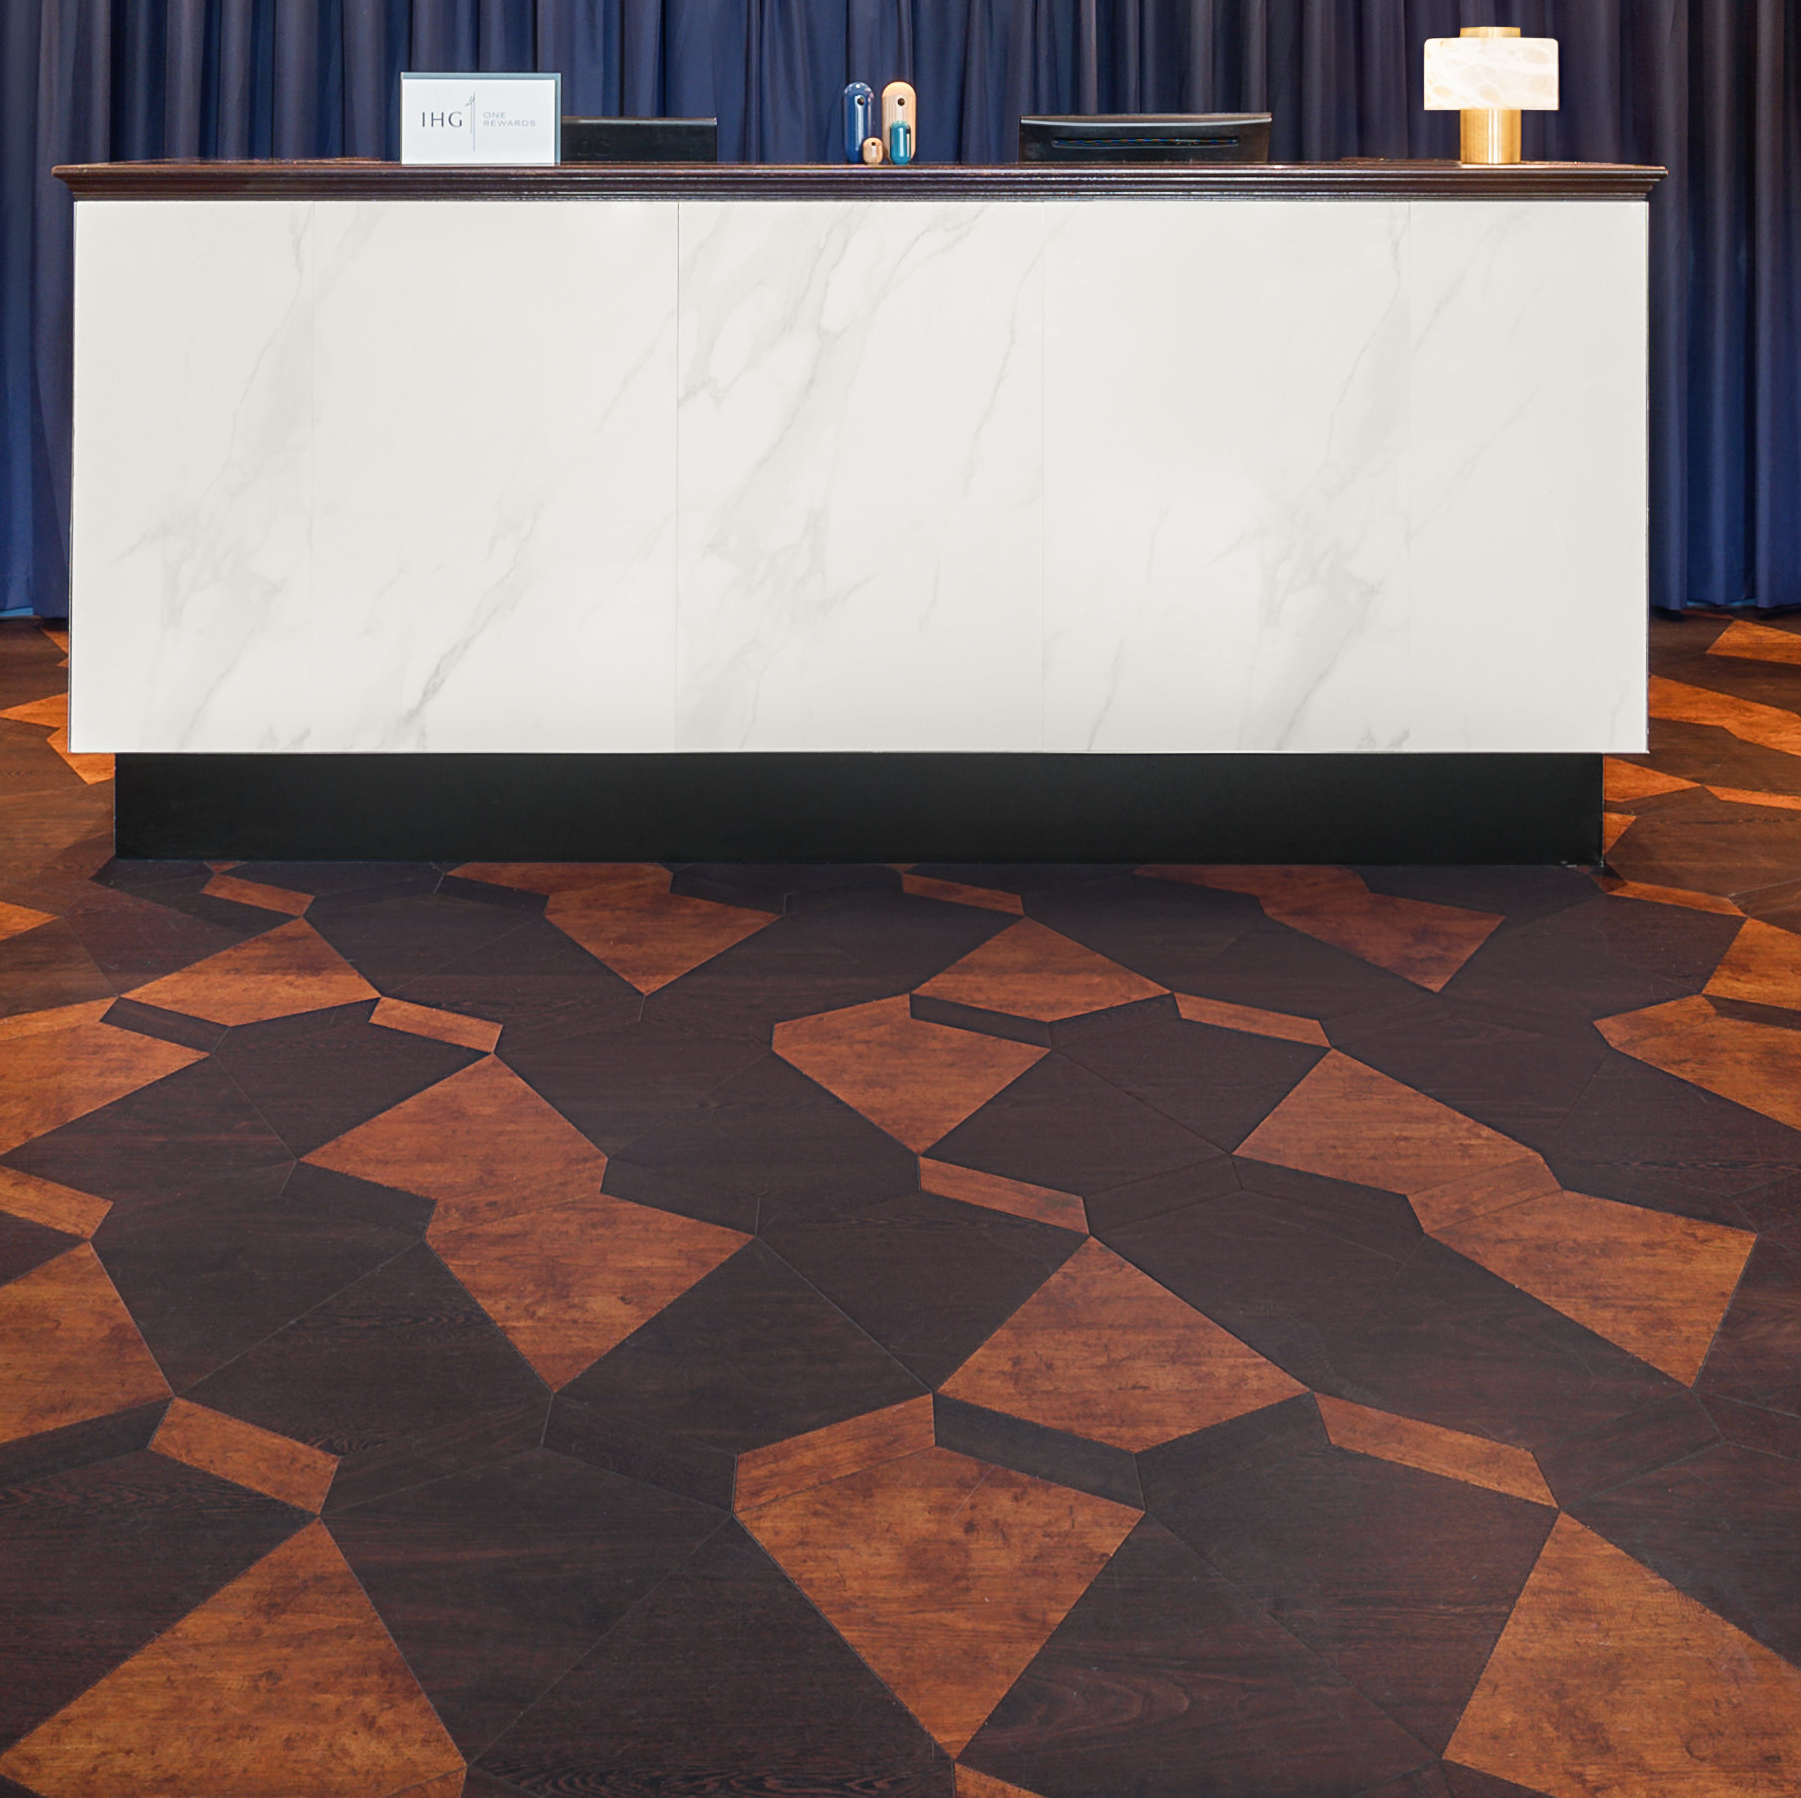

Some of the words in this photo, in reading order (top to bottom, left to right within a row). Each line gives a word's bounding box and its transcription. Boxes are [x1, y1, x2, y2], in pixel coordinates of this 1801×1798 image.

[421, 111, 463, 128] IHG
[483, 111, 507, 119] ONE
[483, 119, 537, 128] REWARDS
